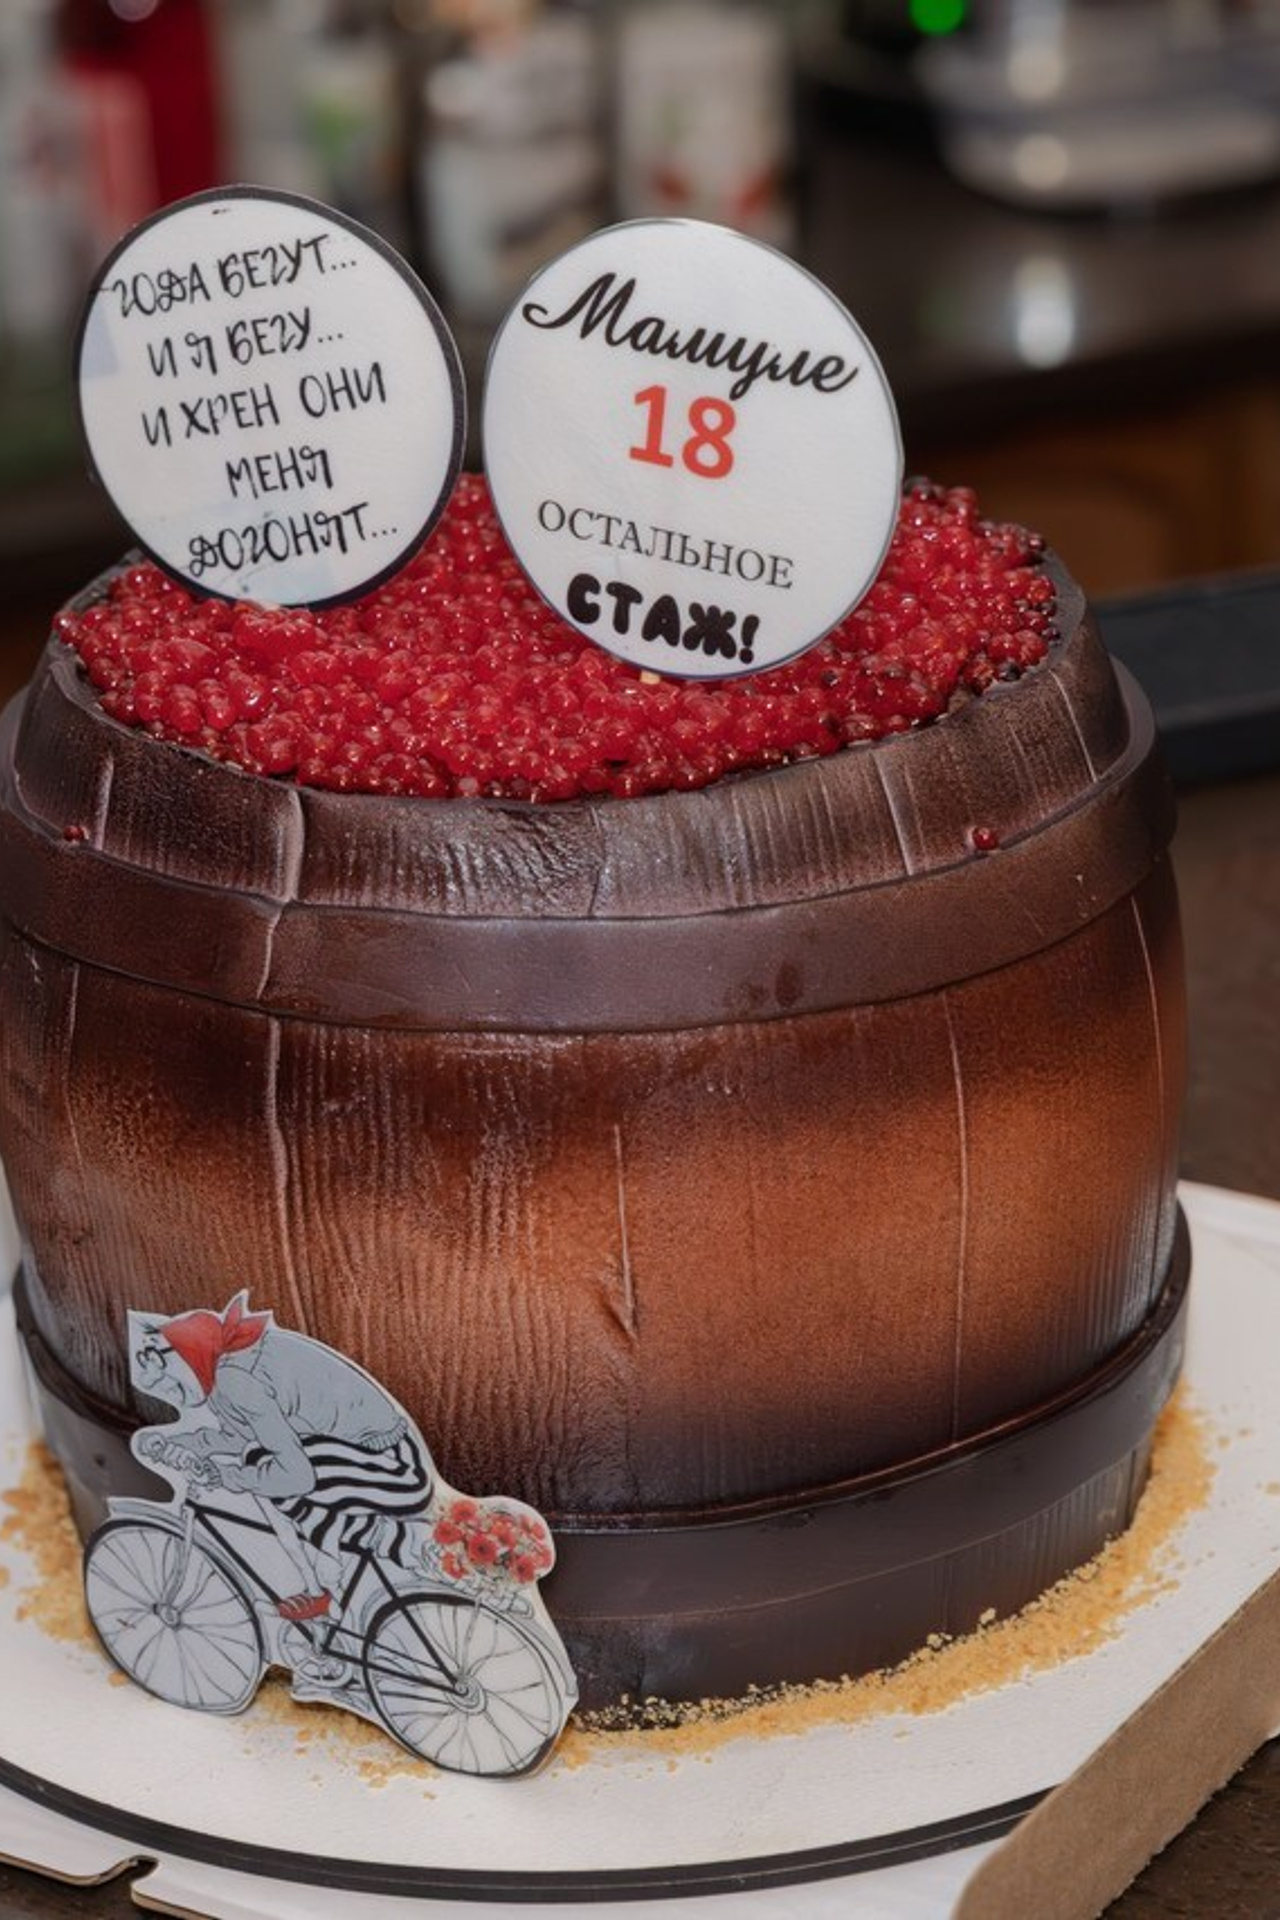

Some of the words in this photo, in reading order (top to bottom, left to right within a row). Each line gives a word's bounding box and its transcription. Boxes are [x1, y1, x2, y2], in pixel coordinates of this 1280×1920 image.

[112, 263, 211, 318] ГОДА
[217, 234, 357, 298] БЕГУТ...
[147, 338, 178, 377] И
[185, 332, 218, 375] Я
[226, 307, 344, 365] БЕГУ...
[521, 272, 860, 401] Мамуле
[142, 407, 173, 447] И
[179, 383, 281, 439] ХРЕН
[299, 362, 388, 418] ОНИ
[629, 384, 737, 480] 18
[226, 446, 334, 500] МЕНЯ
[188, 502, 398, 577] ДОГОНЯТ...
[537, 500, 796, 590] ОСТАЛЬНОЕ
[566, 573, 761, 665] СТАЖ!
